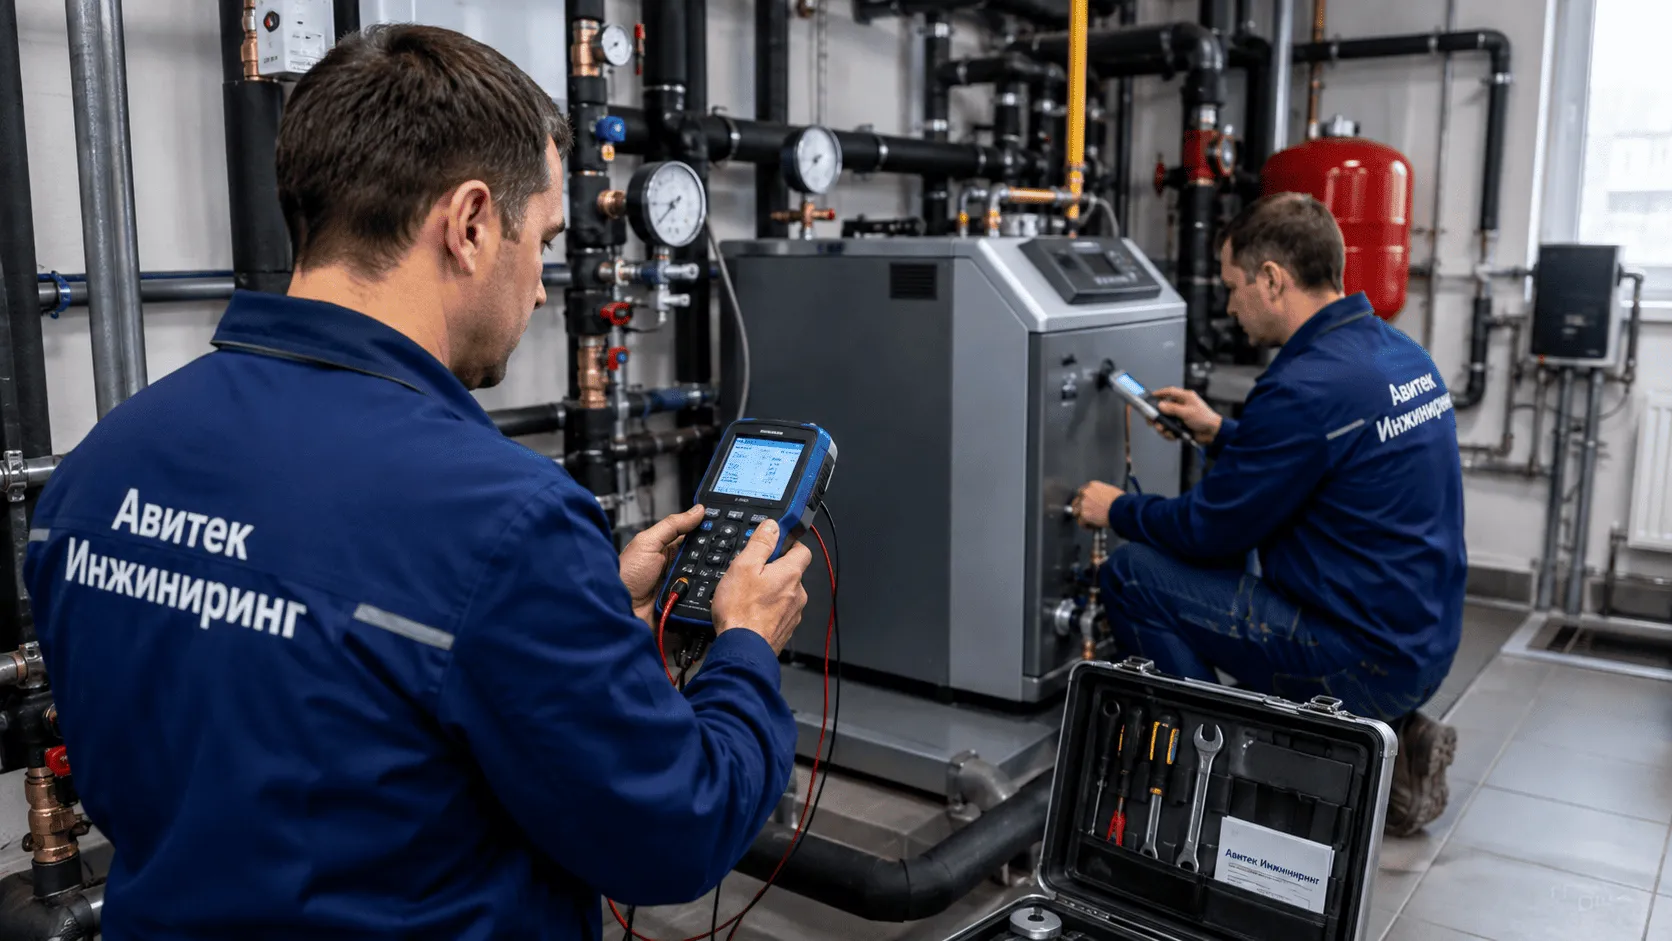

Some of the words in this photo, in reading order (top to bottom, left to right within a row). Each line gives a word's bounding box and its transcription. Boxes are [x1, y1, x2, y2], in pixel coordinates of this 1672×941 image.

[1376, 392, 1453, 442] Инжинирин
[1389, 373, 1437, 406] Авитек
[111, 487, 254, 560] Авитек
[65, 537, 307, 639] Инжиниринг
